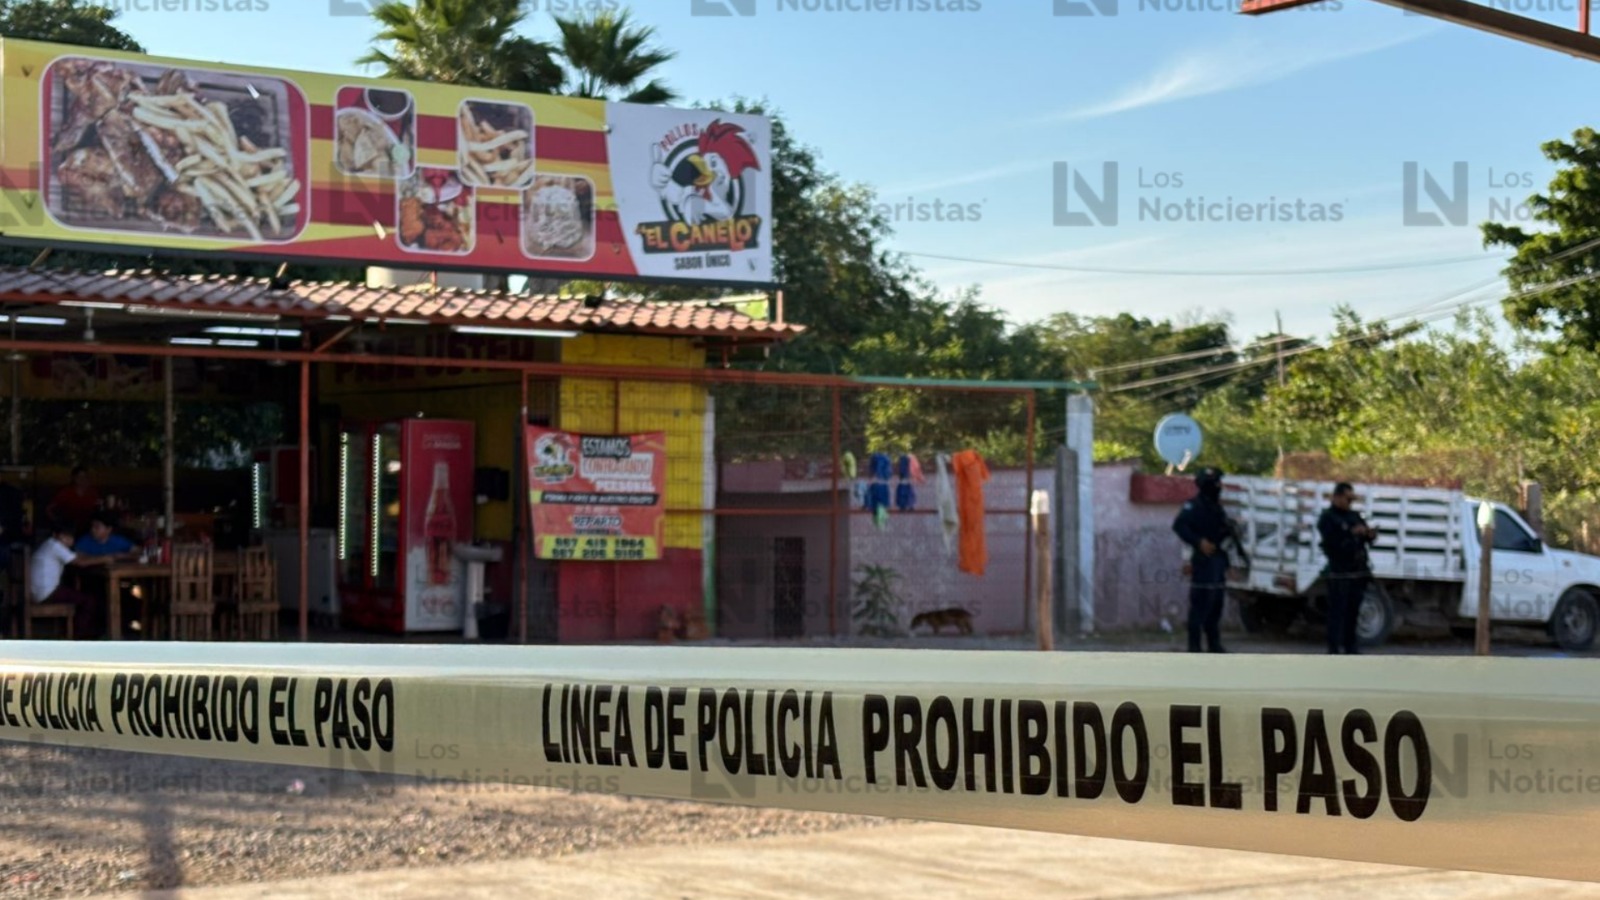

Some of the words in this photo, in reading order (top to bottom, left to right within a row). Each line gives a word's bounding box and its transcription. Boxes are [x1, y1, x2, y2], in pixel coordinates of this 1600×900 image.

[660, 122, 699, 152] POLLOS
[674, 256, 703, 270] SABOR
[582, 437, 630, 457] ESTAMOS
[20, 672, 104, 732] POLICIA
[111, 673, 260, 744] PROHIBIDO
[269, 677, 309, 746] EL
[314, 677, 394, 752] PASO
[542, 683, 638, 768] LINEA
[644, 686, 689, 771] DE
[698, 687, 842, 780] POLICIA
[863, 694, 1149, 804] PROHIBIDO
[1169, 704, 1242, 810] EL
[1261, 707, 1431, 822] PASO
